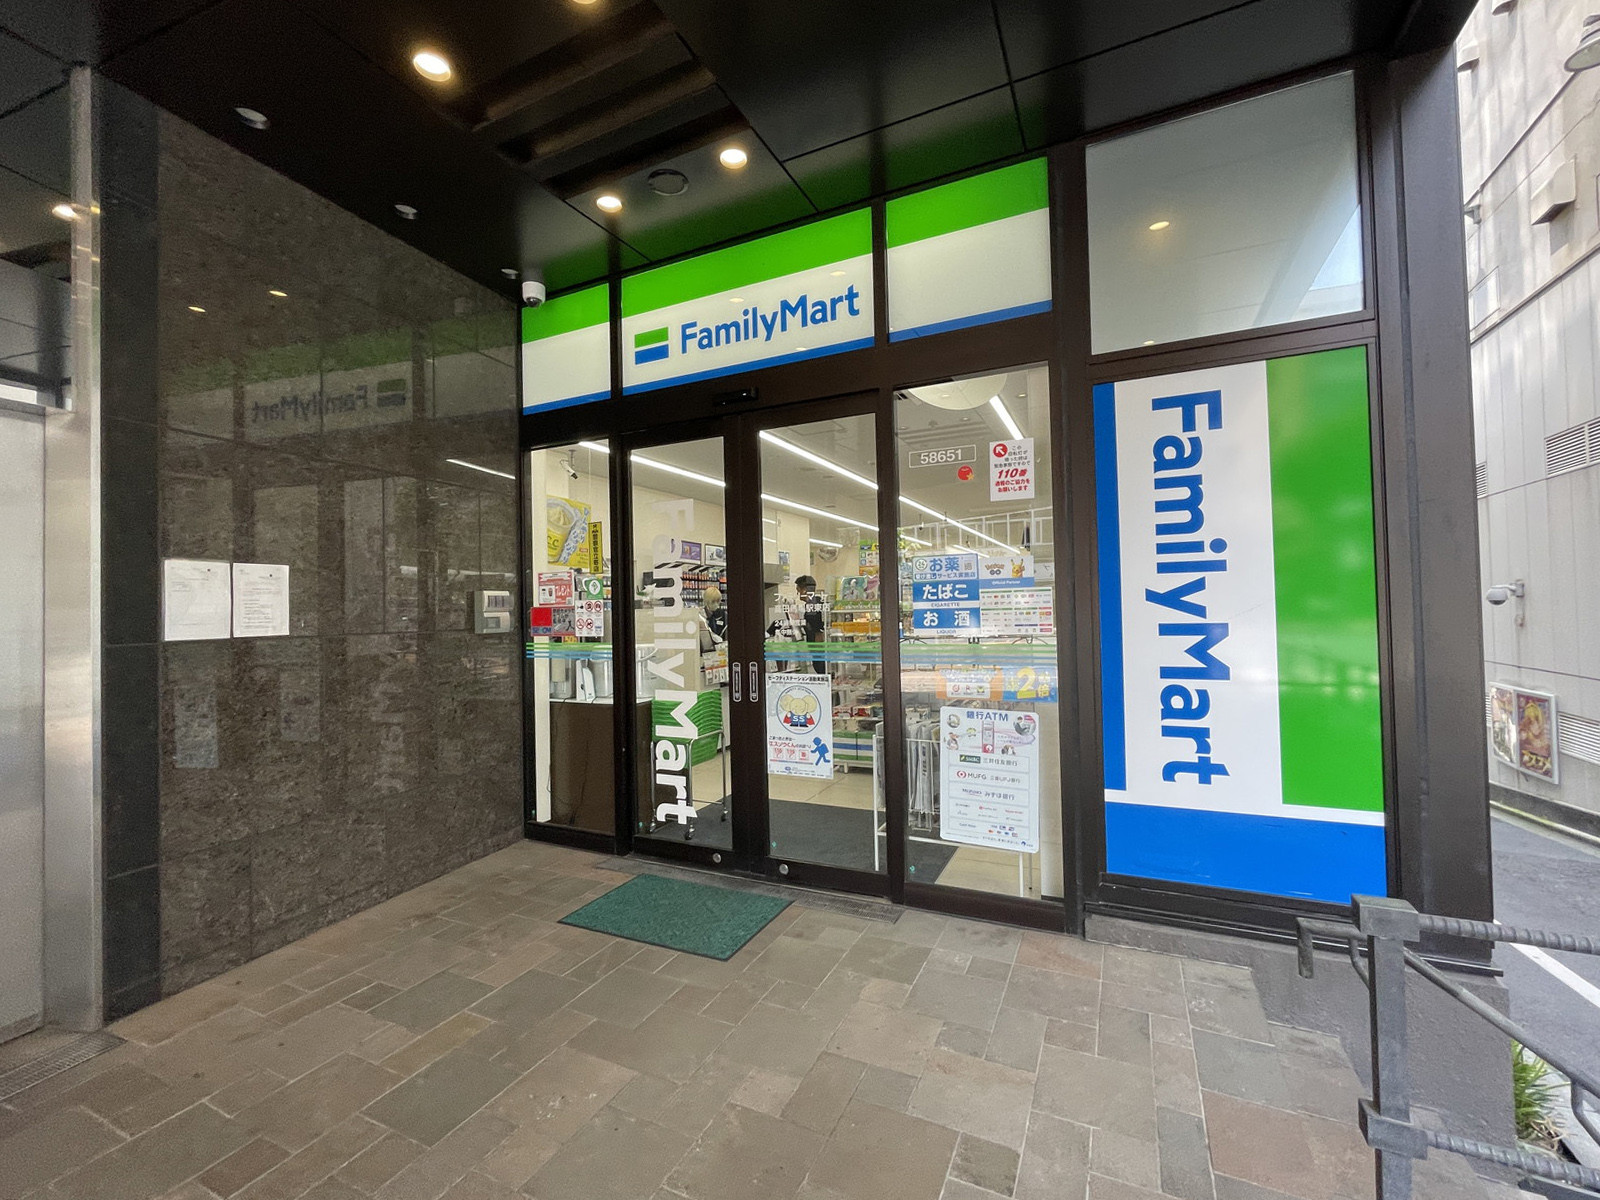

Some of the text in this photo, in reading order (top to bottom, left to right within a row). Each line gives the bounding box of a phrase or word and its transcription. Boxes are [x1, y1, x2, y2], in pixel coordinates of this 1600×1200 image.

[681, 285, 860, 354] FamilyMart
[920, 449, 962, 465] 58651
[929, 557, 959, 572] お薬
[922, 583, 969, 600] たばこ
[1145, 389, 1231, 785] FamilyMart
[648, 499, 698, 825] FamilyMart
[966, 711, 1008, 721] 銀行ATM
